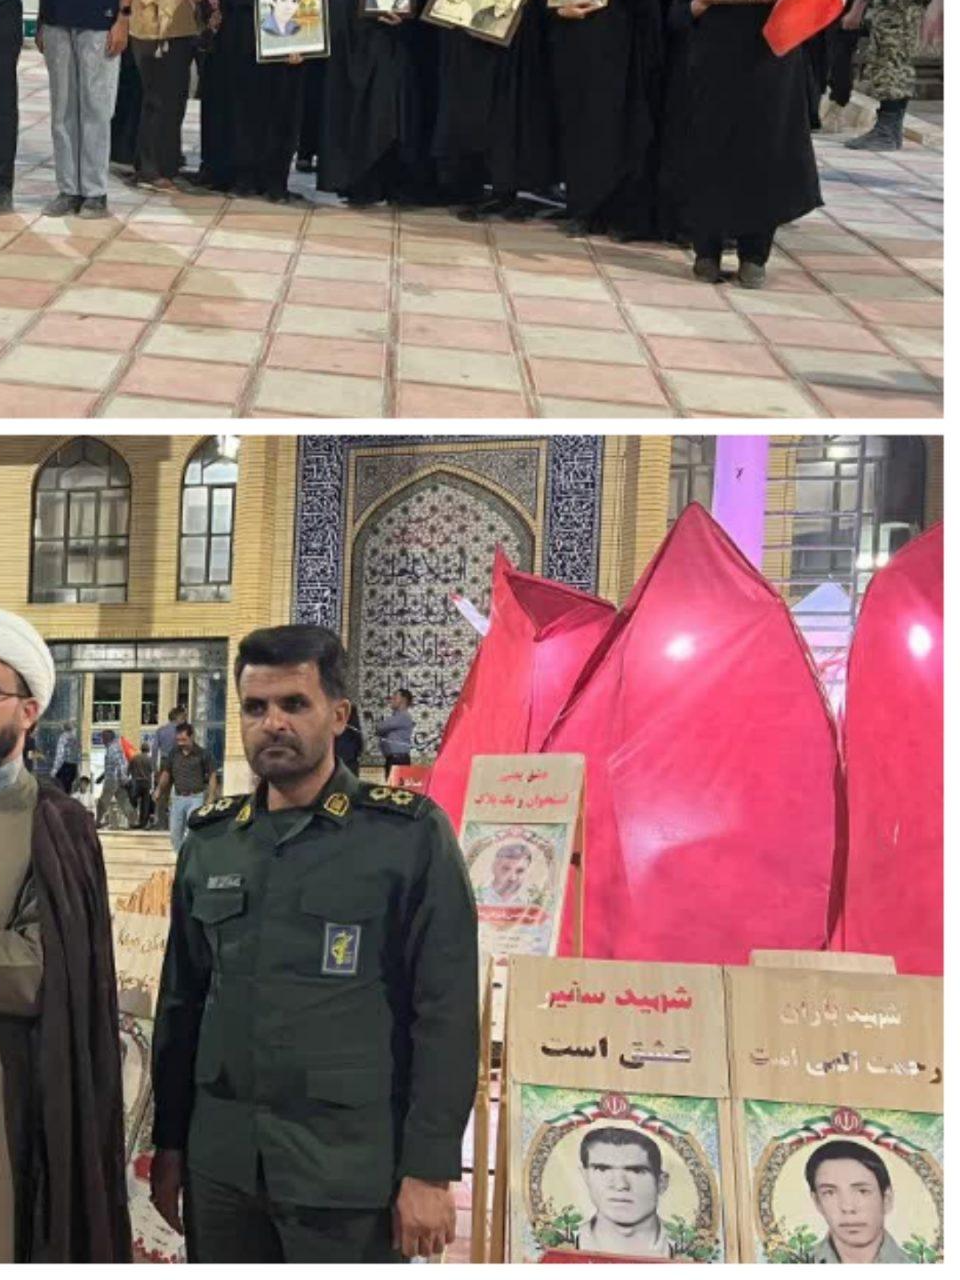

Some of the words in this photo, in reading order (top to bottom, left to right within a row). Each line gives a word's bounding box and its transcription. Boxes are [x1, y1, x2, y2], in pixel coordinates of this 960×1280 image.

[615, 986, 693, 1014] شهید
[845, 1003, 902, 1030] شهید
[541, 1035, 609, 1058] است
[619, 1039, 691, 1069] عشق
[750, 1047, 799, 1067] است
